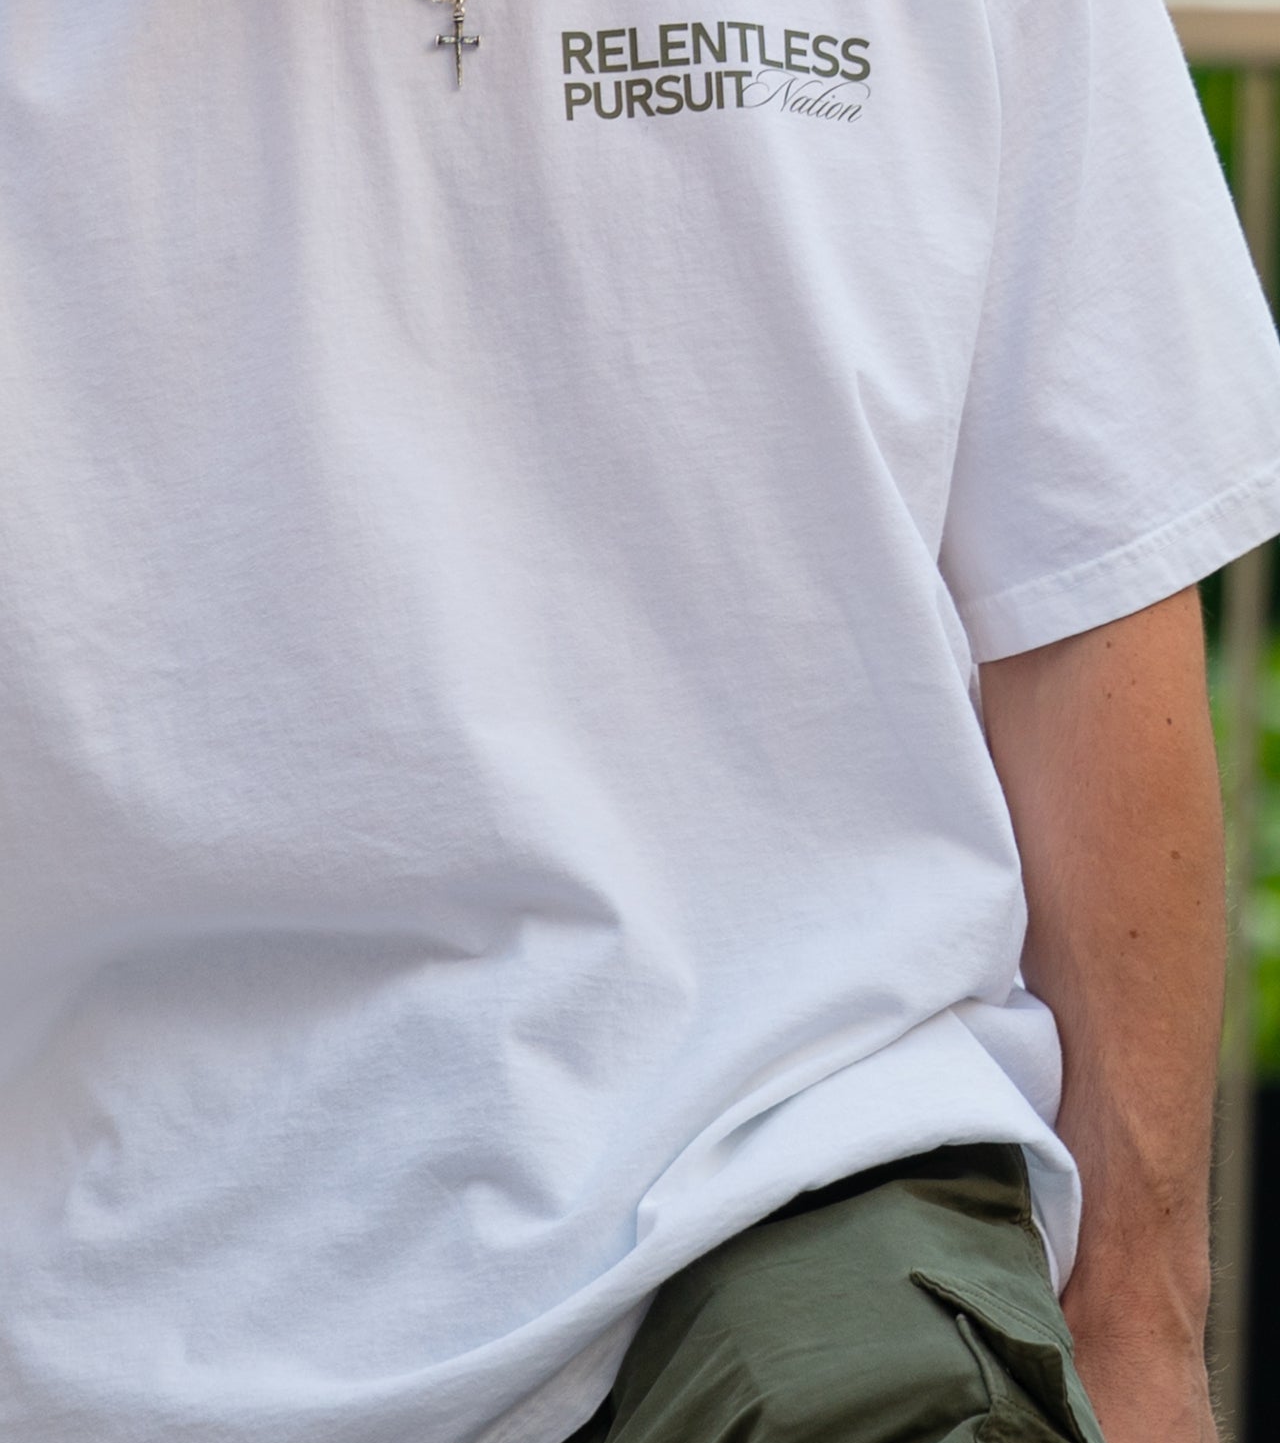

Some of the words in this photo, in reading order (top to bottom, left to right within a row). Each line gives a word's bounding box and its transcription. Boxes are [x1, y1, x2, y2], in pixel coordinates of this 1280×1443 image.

[561, 20, 871, 82] RELENTLESS
[563, 70, 753, 121] PURSUIT
[741, 68, 871, 123] Nation
